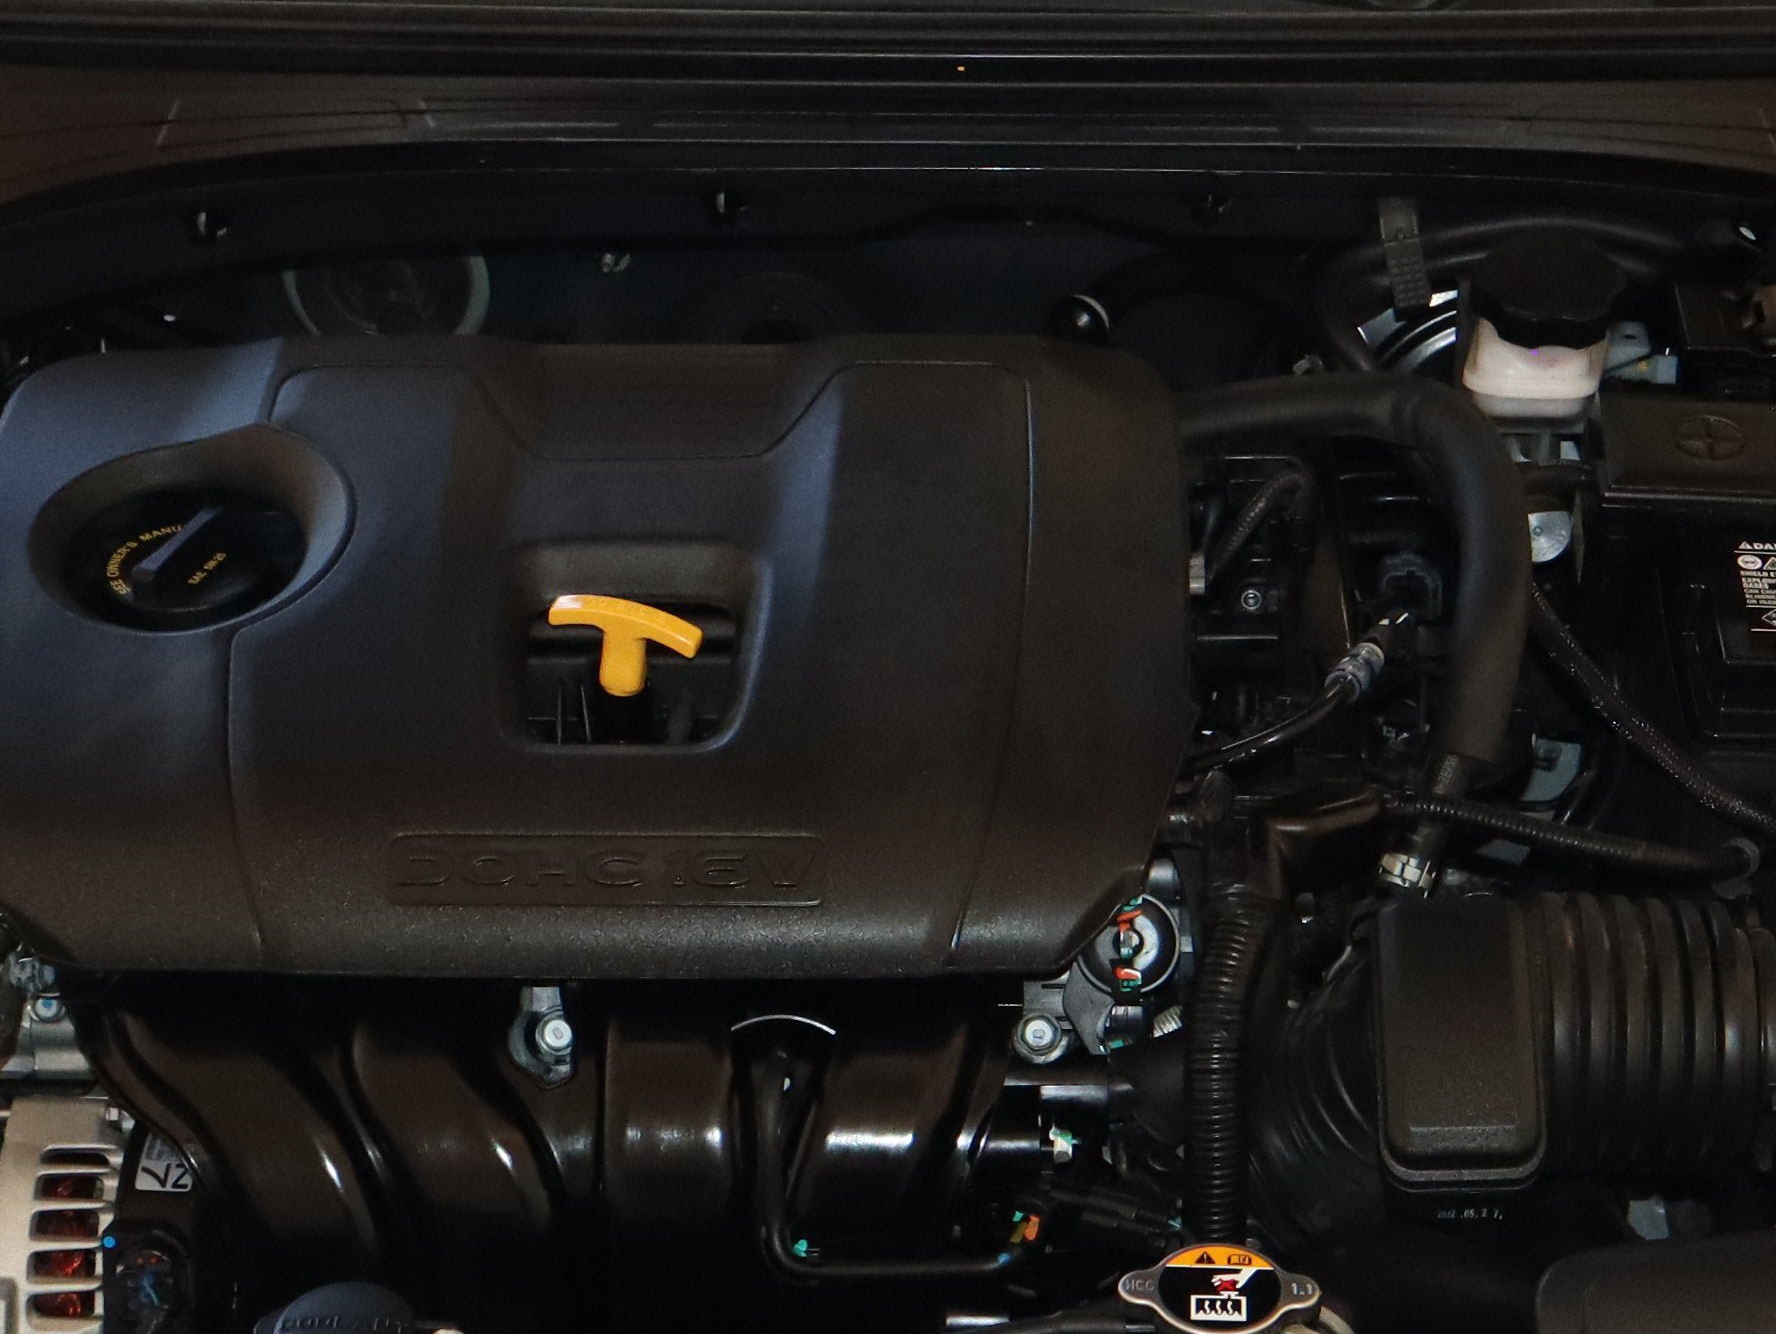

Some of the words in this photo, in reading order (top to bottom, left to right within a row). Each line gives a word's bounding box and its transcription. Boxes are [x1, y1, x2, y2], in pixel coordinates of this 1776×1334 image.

[138, 524, 182, 542] MANU
[394, 850, 646, 889] DOHC
[1291, 1281, 1314, 1296] 1.1
